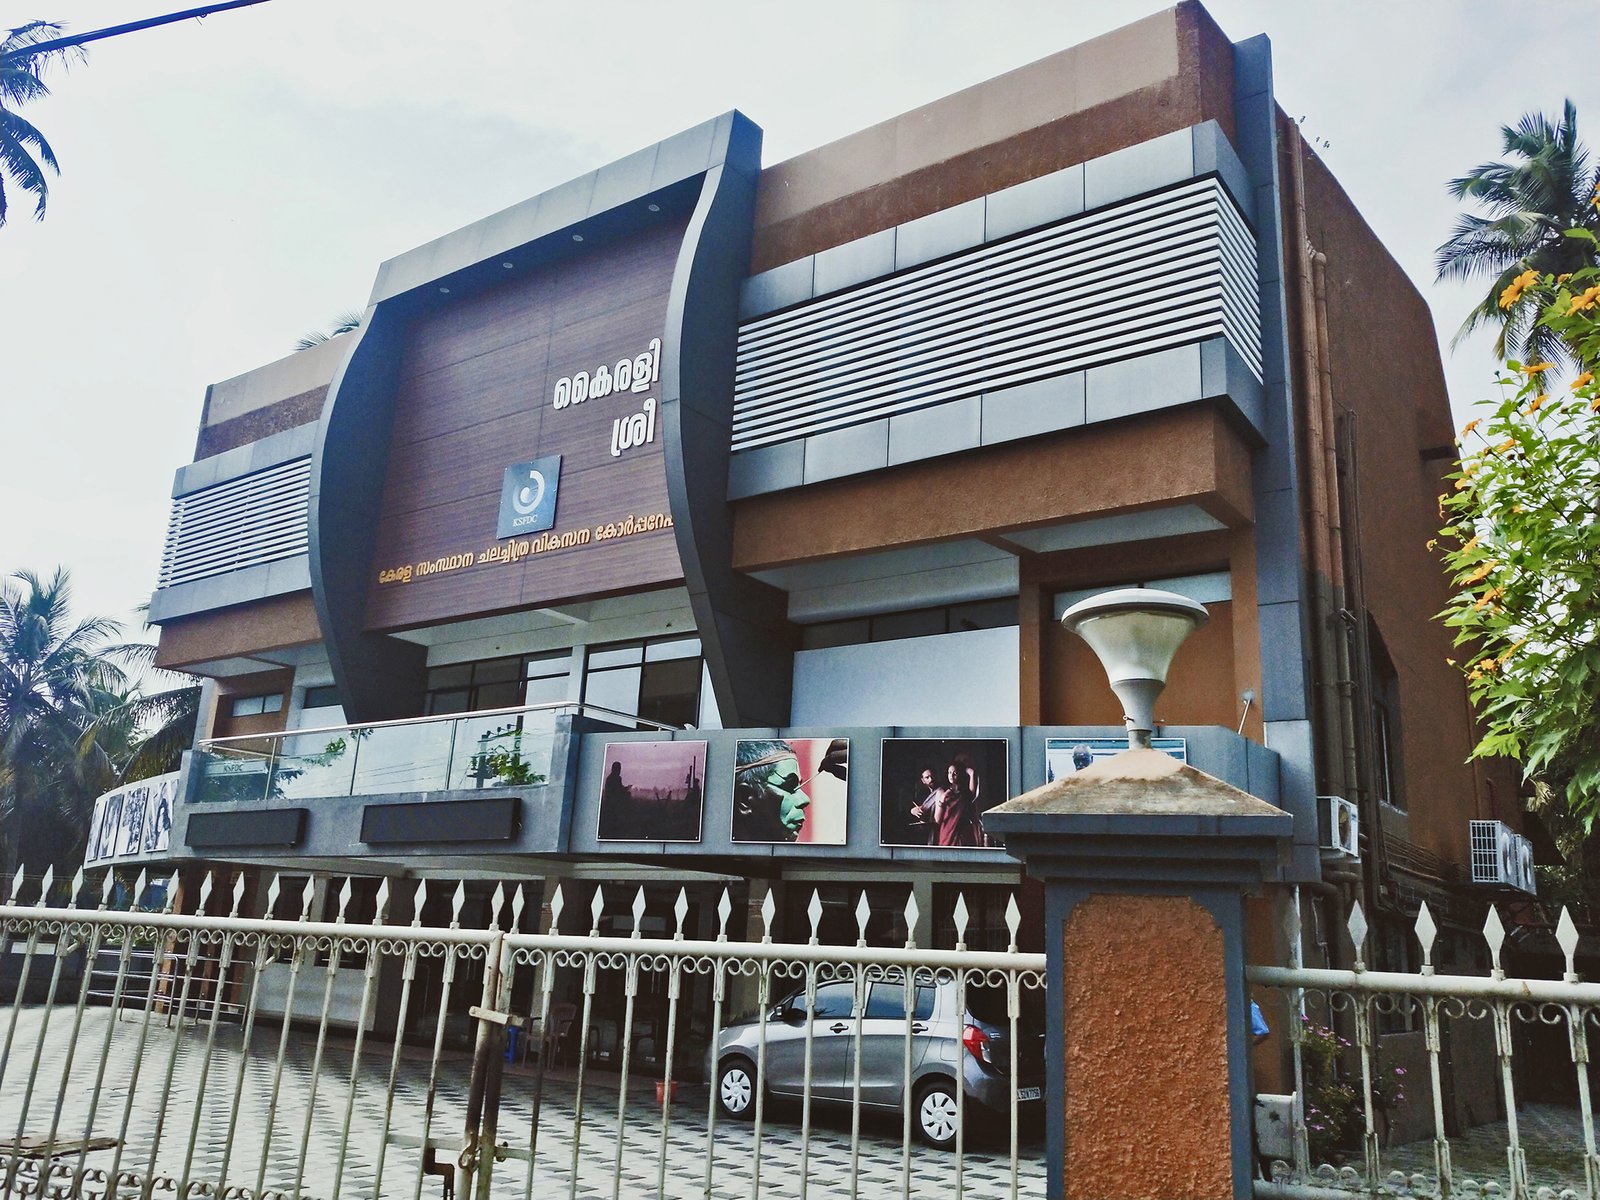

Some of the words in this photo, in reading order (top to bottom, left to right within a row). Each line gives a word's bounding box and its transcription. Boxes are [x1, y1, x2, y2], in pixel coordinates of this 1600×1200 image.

[553, 338, 662, 410] കൈരളി
[611, 398, 657, 457] ശ്രീ
[512, 514, 538, 527] KSFDC
[379, 565, 412, 584] കേരള
[416, 552, 474, 576] സംസ്ഥാന
[477, 539, 530, 564] ചലച്ചിത്ര
[531, 532, 591, 555] വികസന
